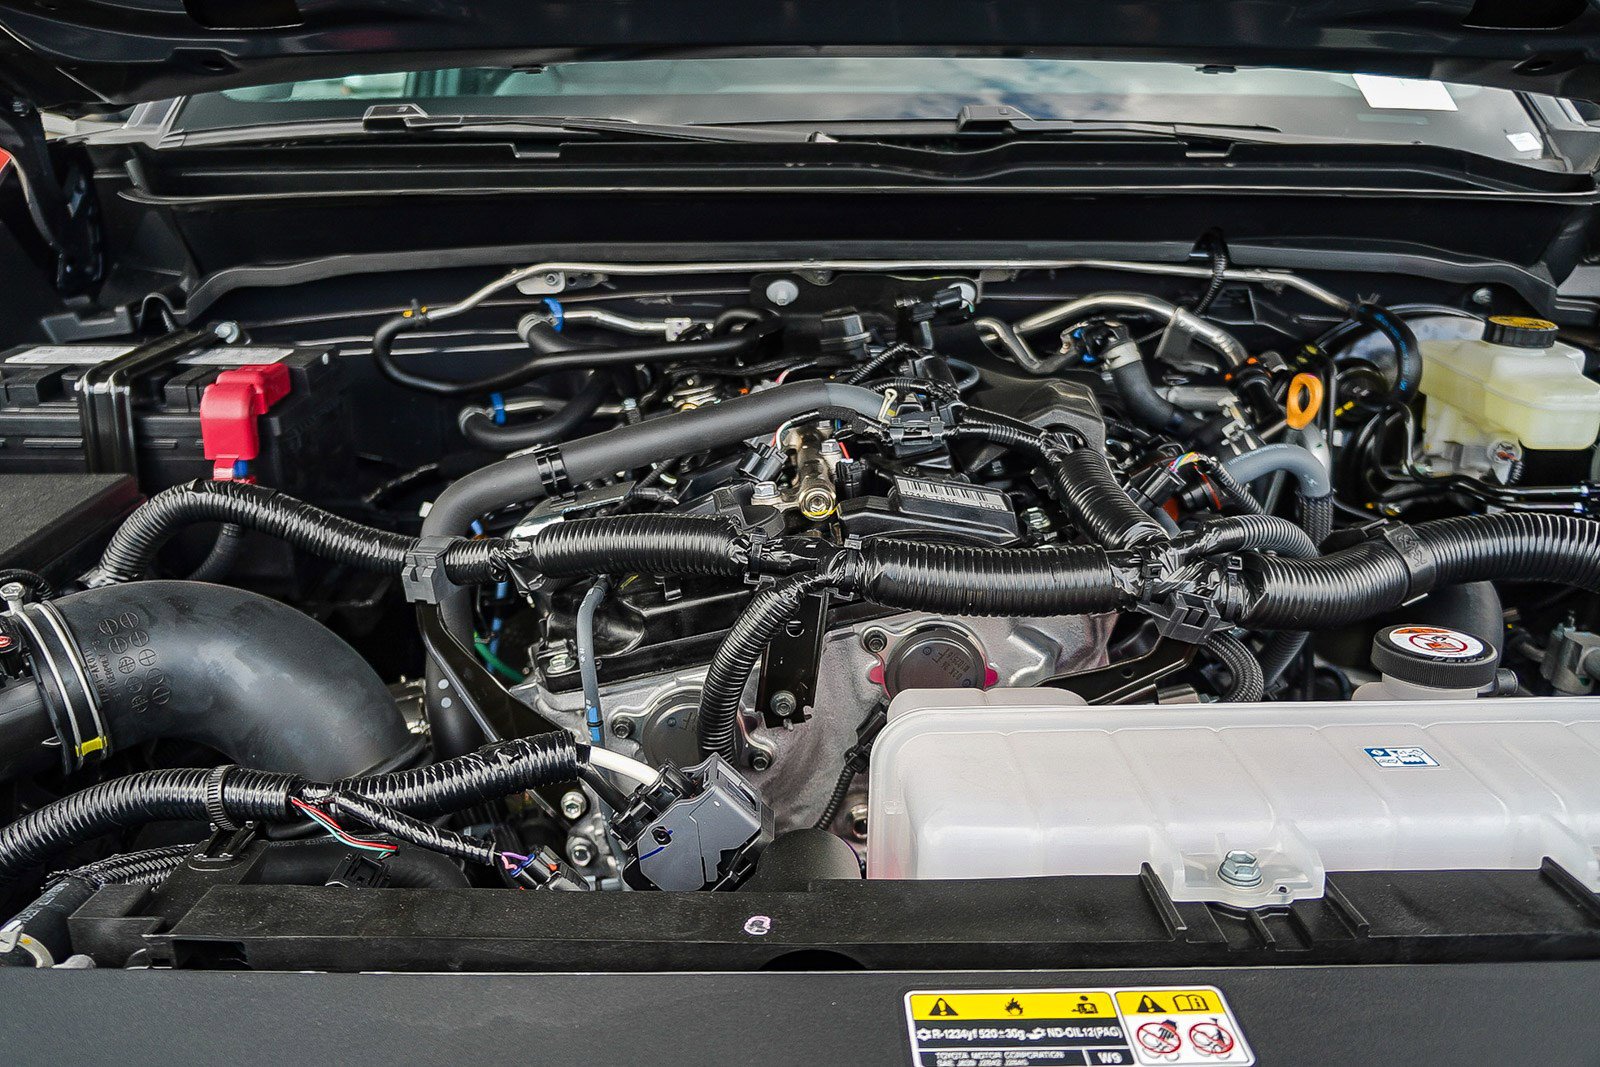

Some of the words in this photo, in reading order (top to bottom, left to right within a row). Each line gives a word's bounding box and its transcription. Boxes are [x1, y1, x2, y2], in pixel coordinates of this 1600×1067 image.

[979, 1027, 1026, 1041] 520±30g
[1047, 1026, 1123, 1039] ND-OIL12(PAG)
[1098, 1052, 1123, 1064] W9
